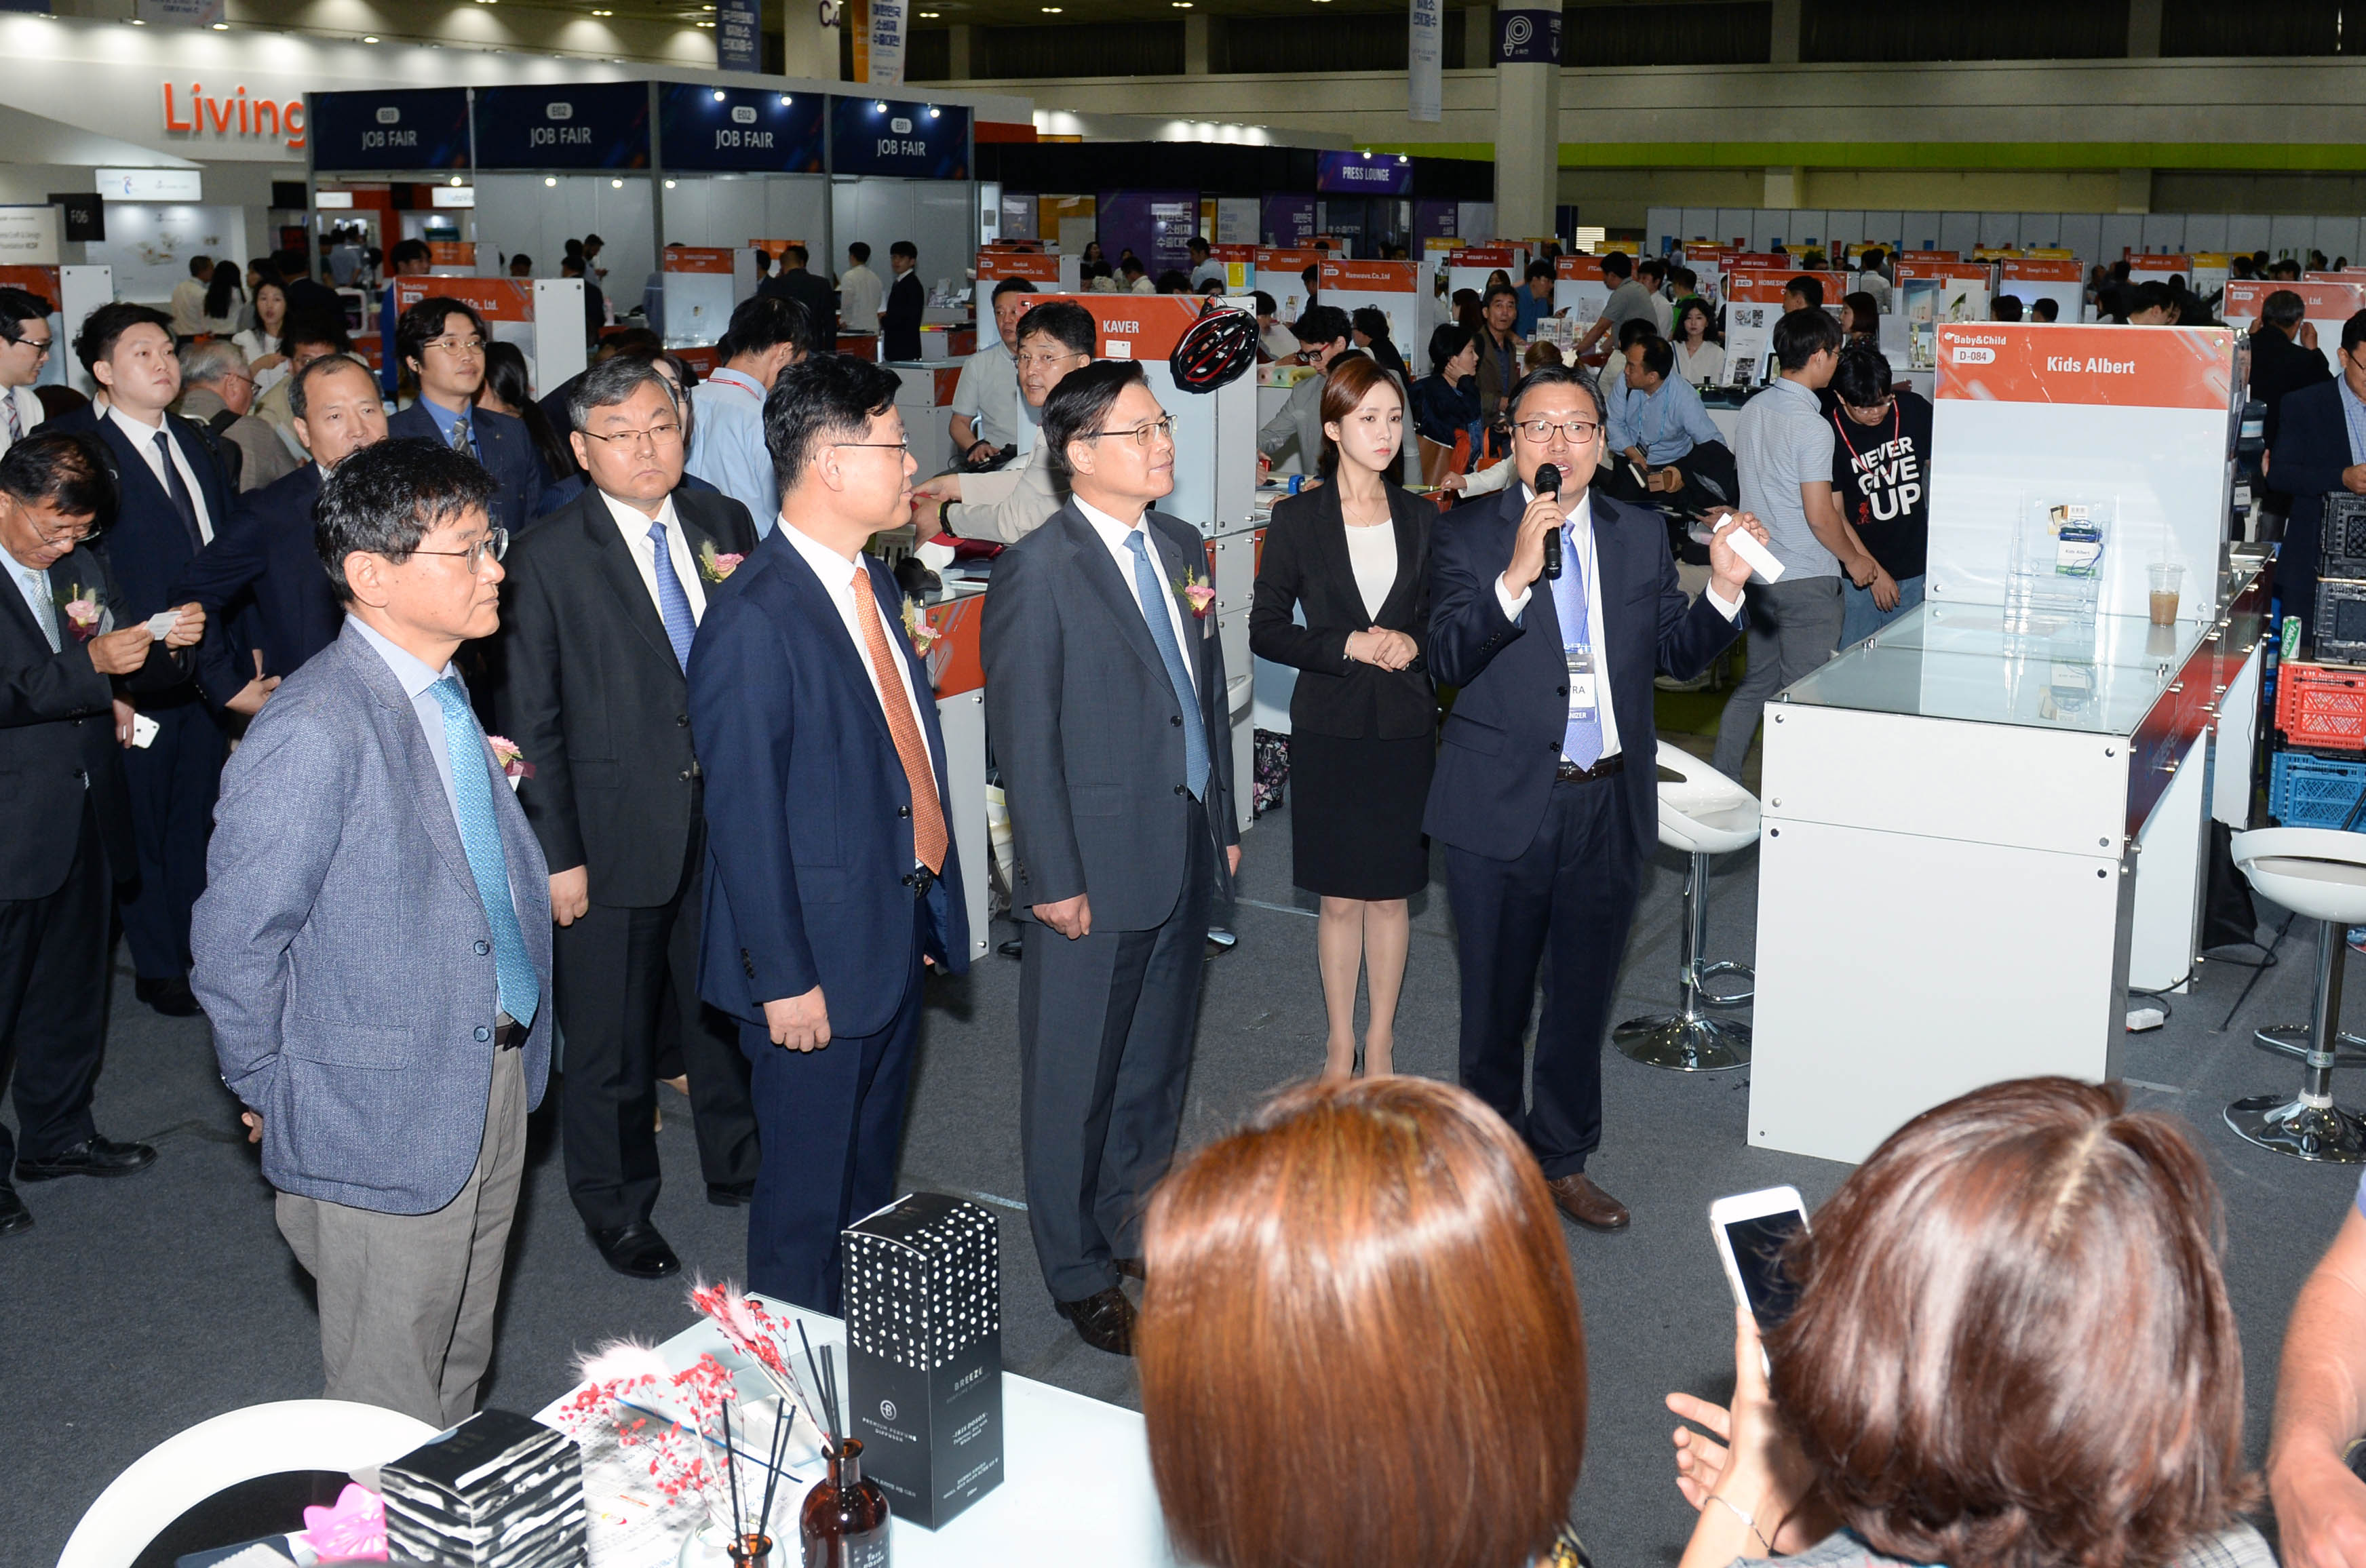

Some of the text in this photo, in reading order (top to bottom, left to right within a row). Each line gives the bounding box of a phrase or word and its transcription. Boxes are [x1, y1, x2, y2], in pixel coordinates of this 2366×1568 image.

[819, 1, 841, 28] C4
[163, 82, 305, 149] Living
[362, 130, 418, 151] JOB FAIR
[530, 127, 592, 148] JOB FAIR
[716, 130, 774, 150] JOB FAIR
[877, 138, 926, 157] JOB FAIR
[1342, 166, 1390, 182] PRESS LOUNGE
[70, 209, 90, 224] F06
[1156, 211, 1192, 222] 대한민국
[1166, 224, 1192, 235] 소비재
[484, 299, 499, 311] Ltd.
[2308, 297, 2323, 305] Ltd.
[1103, 319, 1140, 334] KAVER
[1954, 334, 2006, 346] Baby&Child
[1960, 351, 1987, 361] D-084
[2047, 356, 2135, 374] Kids Albert
[1850, 436, 1914, 474] NEVER
[1859, 455, 1920, 496] GIVE
[1869, 482, 1921, 521] UP
[954, 1366, 983, 1391] BREEZE
[862, 1417, 917, 1442] PREMIUM PERFUME
[875, 1428, 904, 1443] DIFFUSER
